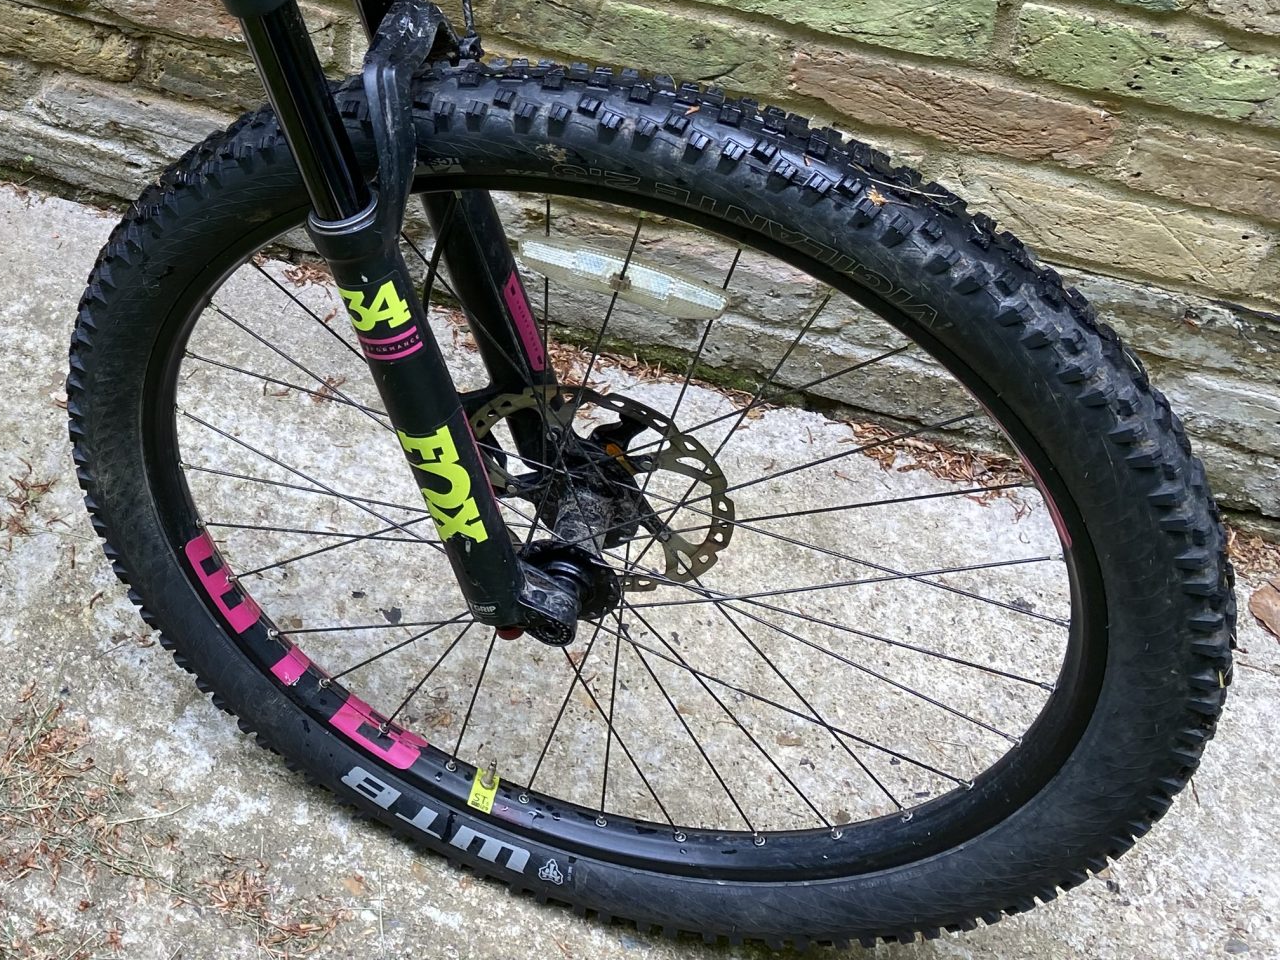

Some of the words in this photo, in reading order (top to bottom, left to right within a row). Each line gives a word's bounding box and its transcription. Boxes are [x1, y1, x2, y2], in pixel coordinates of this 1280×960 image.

[339, 280, 412, 332] 34
[655, 182, 938, 329] VIGILANTE
[397, 425, 489, 544] FOX
[340, 766, 532, 874] WTB
